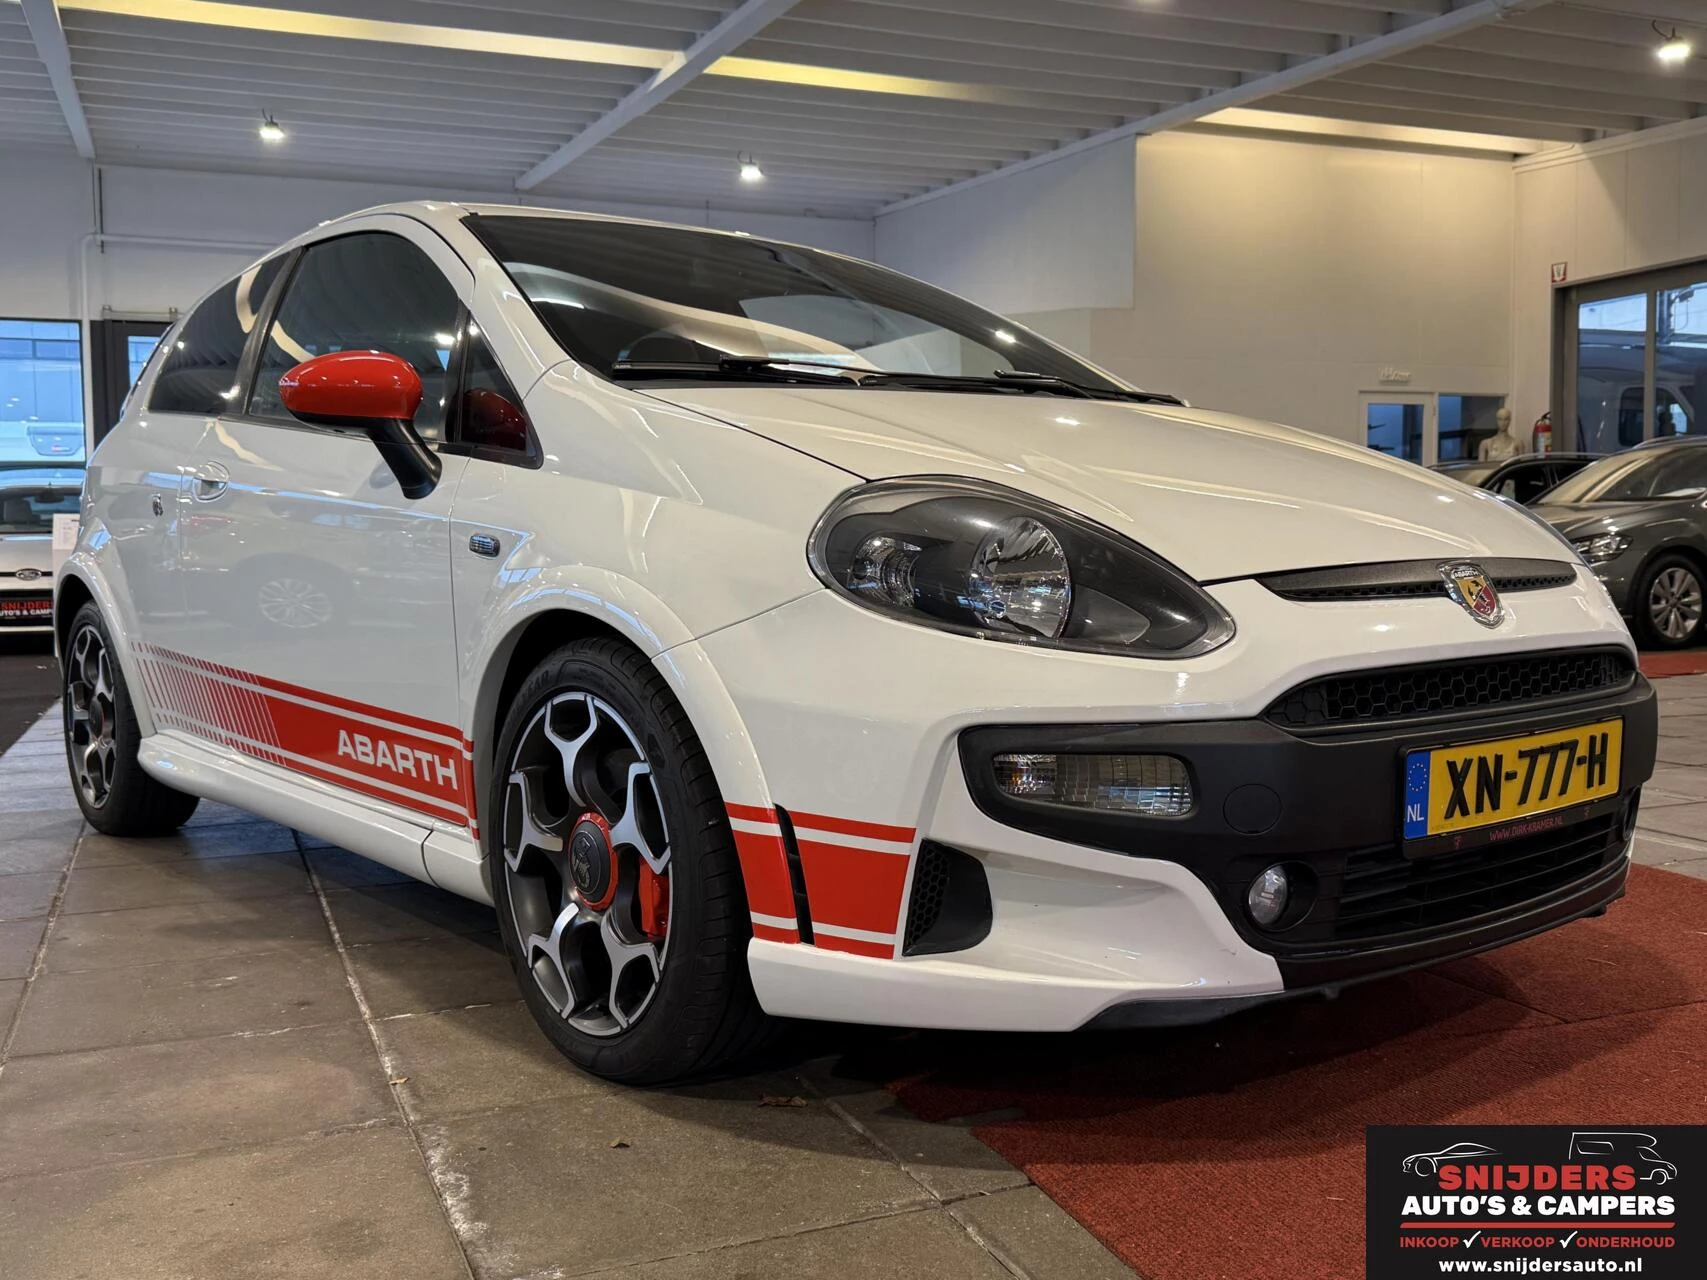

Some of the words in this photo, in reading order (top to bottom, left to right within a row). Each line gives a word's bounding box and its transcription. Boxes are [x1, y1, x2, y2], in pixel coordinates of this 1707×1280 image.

[337, 729, 459, 790] ABARTH
[1444, 732, 1609, 820] XN-777-H
[1407, 804, 1425, 823] NL
